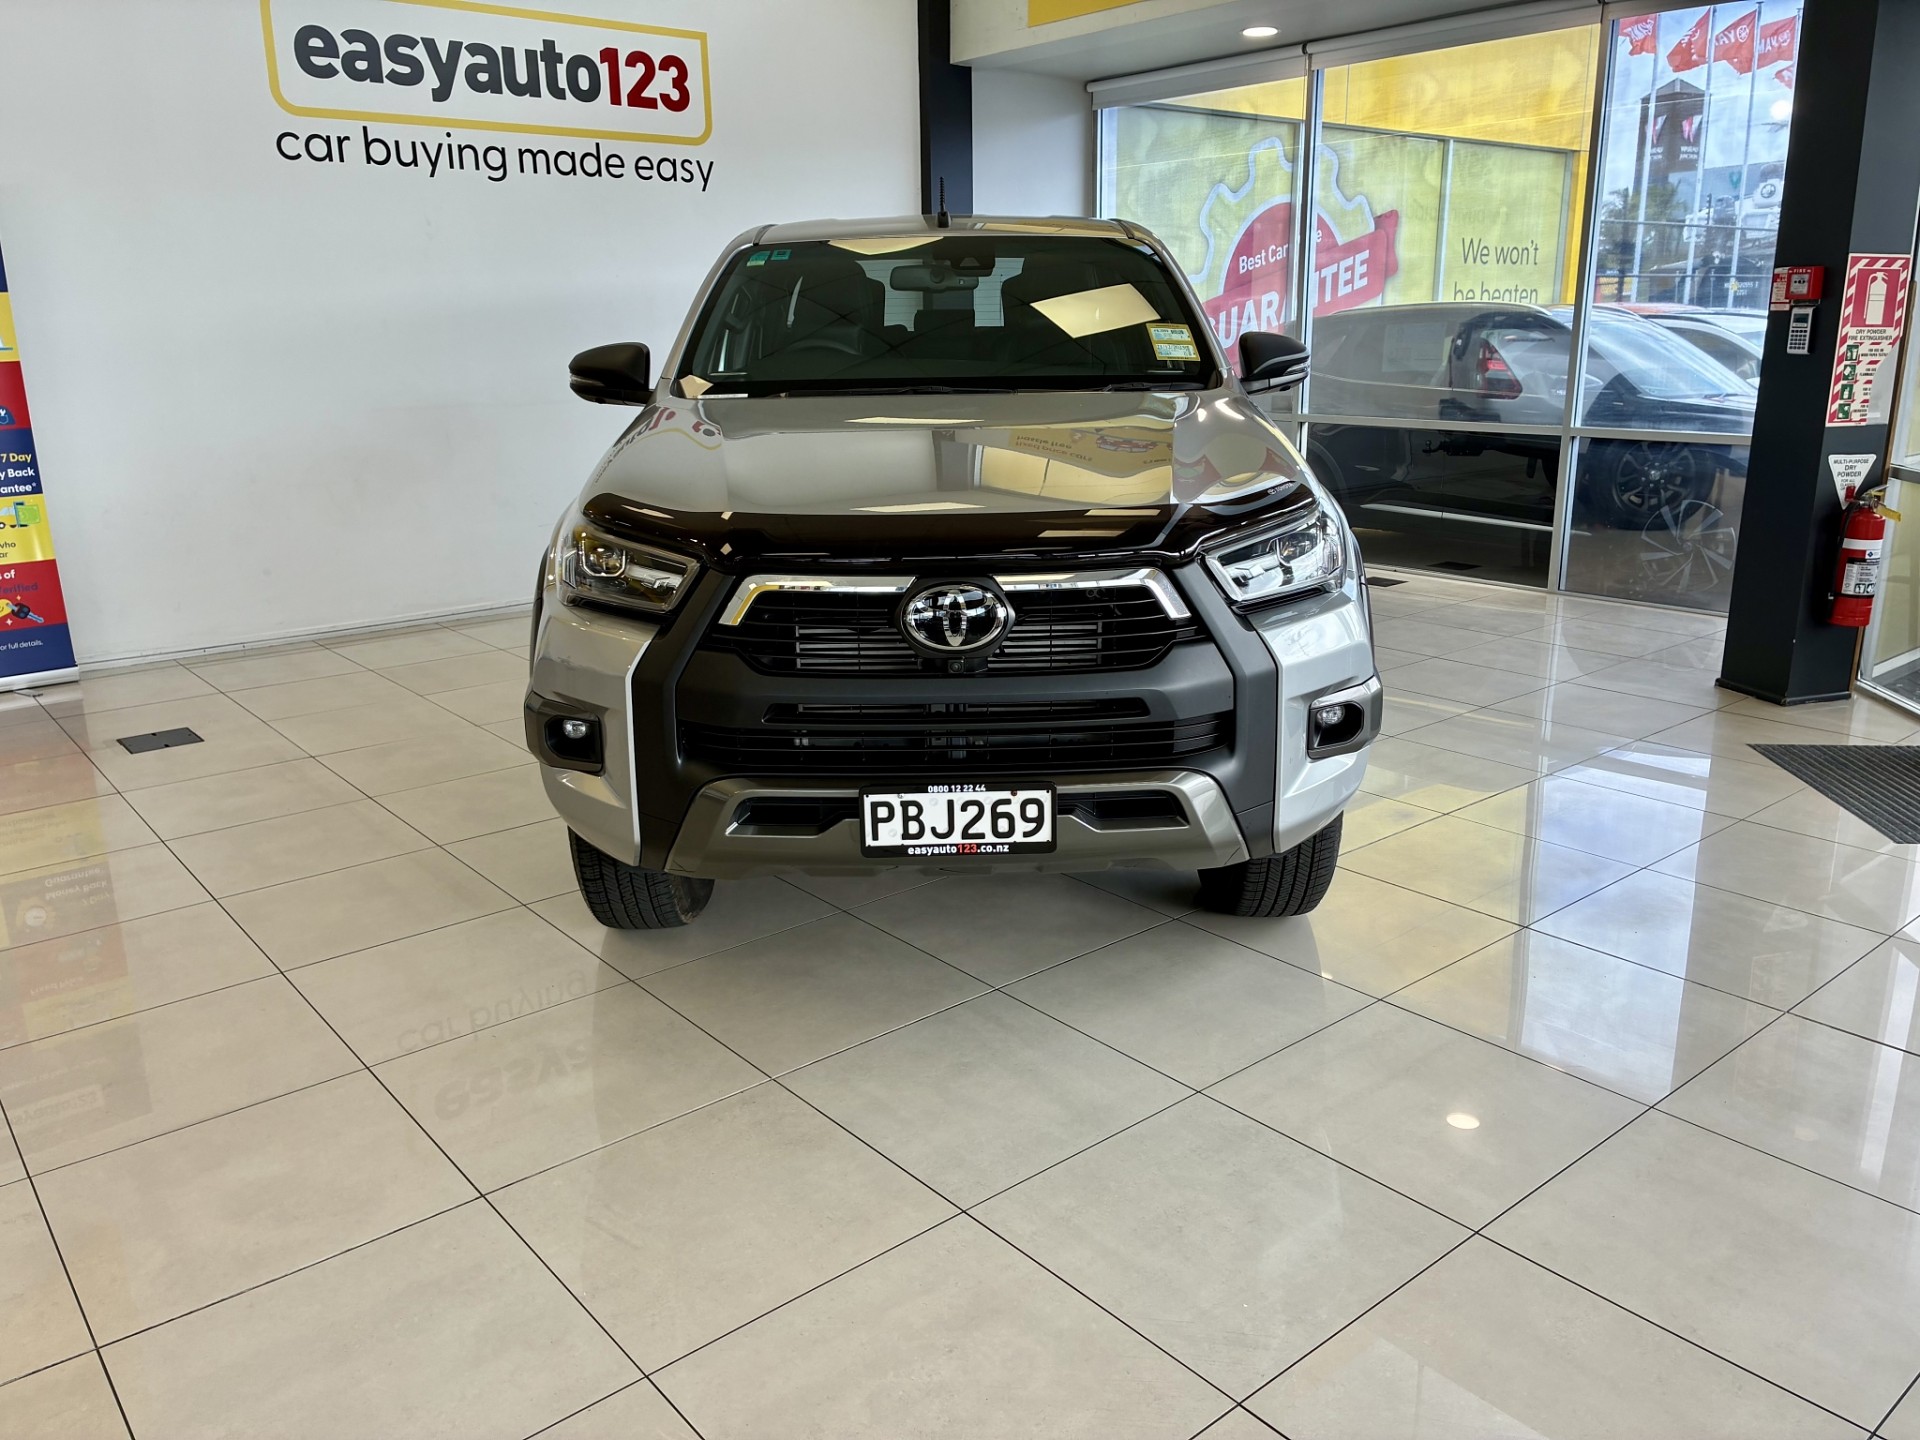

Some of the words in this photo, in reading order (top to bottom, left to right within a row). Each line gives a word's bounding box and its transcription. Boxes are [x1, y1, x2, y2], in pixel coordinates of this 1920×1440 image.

[293, 24, 691, 113] easyauto123
[275, 130, 351, 163] car
[361, 126, 508, 182] buying
[517, 142, 626, 179] made
[633, 154, 714, 192] easy
[1461, 237, 1490, 265] We
[1494, 239, 1539, 266] won't
[1239, 249, 1267, 275] Best
[1268, 243, 1289, 263] Car
[9, 453, 32, 463] Day
[7, 467, 36, 478] Back
[0, 551, 9, 559] ar
[3, 569, 15, 579] of
[0, 582, 38, 594] erified
[8, 642, 19, 650] full
[19, 639, 44, 649] details.
[927, 785, 950, 793] 0800
[950, 785, 962, 793] 12
[963, 784, 974, 792] 22
[975, 784, 987, 792] 44
[870, 797, 1045, 842] PBJ269
[907, 843, 1010, 857] easyauto123.co.nz
